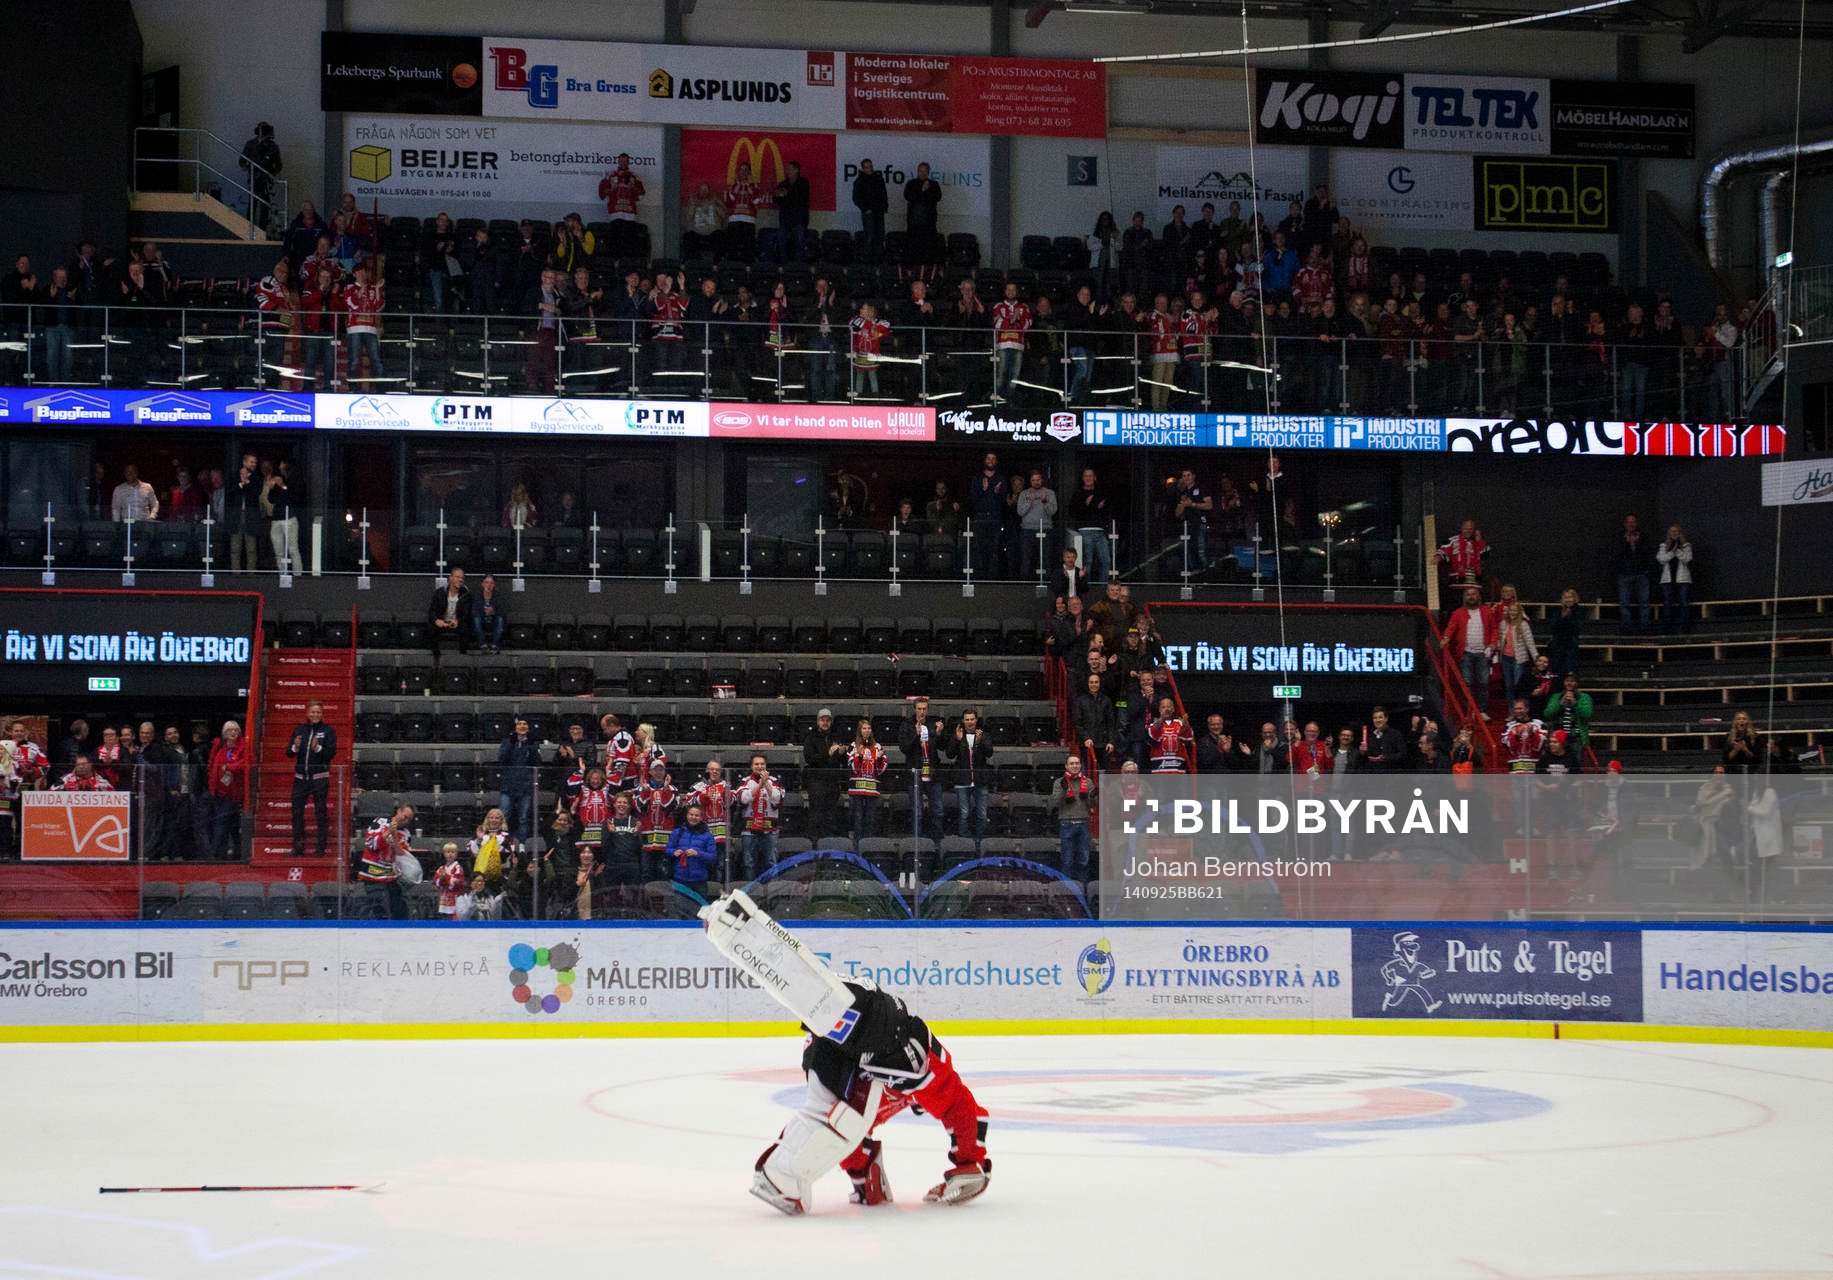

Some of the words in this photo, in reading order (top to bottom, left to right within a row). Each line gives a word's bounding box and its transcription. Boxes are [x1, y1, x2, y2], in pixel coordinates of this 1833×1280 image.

[326, 63, 386, 80] Lekebergs
[388, 65, 443, 80] Sparbank
[854, 56, 906, 69] Moderna
[909, 59, 950, 70] lokaler
[853, 72, 859, 83] i
[863, 72, 913, 86] Sveriges
[987, 66, 1081, 80] AKUSTIKMONTAGE
[1083, 70, 1097, 80] AB
[566, 78, 592, 92] Bra
[596, 80, 637, 94] Gross
[678, 78, 792, 103] ASPLUNDS
[853, 87, 950, 101] logistikcentrum.
[1411, 86, 1540, 130] TELTEK
[356, 123, 395, 139] FRÅGA
[400, 123, 441, 139] NÅGON
[446, 128, 470, 140] SOM
[475, 127, 497, 139] VET
[1412, 128, 1545, 143] PRODUKTKONTROLL
[401, 149, 499, 170] BEIJER
[510, 150, 656, 166] betongfabrikencom
[401, 169, 499, 180] BYGGMATERIAL
[1158, 186, 1260, 201] Mellansvenska
[1264, 189, 1304, 201] Fasad
[1488, 182, 1604, 222] pmc
[443, 404, 493, 420] PTM
[636, 409, 685, 424] PTM
[887, 412, 925, 427] WALLIN
[938, 409, 973, 427] Team
[756, 414, 769, 426] Vi
[772, 416, 791, 427] tar
[794, 415, 826, 428] hand
[828, 418, 848, 428] om
[851, 416, 882, 430] bilen
[954, 417, 985, 434] Nya
[986, 414, 1042, 433] Åkeriet
[1121, 413, 1197, 430] INDUSTRI
[1251, 416, 1325, 433] INDUSTRI
[1367, 418, 1441, 435] INDUSTRI
[1012, 432, 1042, 442] Örebro
[1121, 430, 1197, 446] PRODUKTER
[1251, 433, 1325, 449] PRODUKTER
[1367, 435, 1441, 450] PRODUKTER
[5, 630, 36, 661] ÄR
[42, 634, 64, 661] VI
[68, 635, 120, 661] SOM
[124, 631, 155, 662] ÄR
[159, 632, 250, 663] ÖREBRO
[1196, 642, 1224, 671] ÄR
[1228, 646, 1248, 671] VI
[1252, 646, 1298, 672] SOM
[1302, 642, 1330, 672] ÄR
[1334, 643, 1415, 673] ÖREBRO
[24, 794, 64, 806] VIVIDA
[66, 794, 129, 806] ASSISTANS
[764, 918, 803, 952] Reebok
[1182, 939, 1270, 963] ÖREBRO
[135, 952, 173, 979] Bil
[341, 956, 490, 978] REKLAMBYRÅ
[733, 942, 791, 993] CONCENT
[1446, 940, 1502, 973] Puts
[1513, 940, 1536, 974] &
[1548, 941, 1613, 982] Tegel
[586, 960, 766, 990] MÅLERIBUTIKE
[844, 958, 1062, 988] Tandvårdshuset
[1083, 967, 1110, 975] SMF
[1125, 964, 1306, 988] FLYTTNINGSBYRÅ
[1312, 969, 1341, 988] AB
[1660, 962, 1833, 994] Handelsba
[34, 980, 88, 997] Örebro
[586, 994, 648, 1006] ÖREBRO
[1151, 994, 1173, 1005] ETT
[1174, 993, 1214, 1005] BÄTTRE
[1216, 993, 1242, 1005] SÄTT
[1244, 995, 1264, 1005] ATT
[1265, 995, 1304, 1006] FLYTTA
[1447, 989, 1612, 1009] www.putsotegel.se
